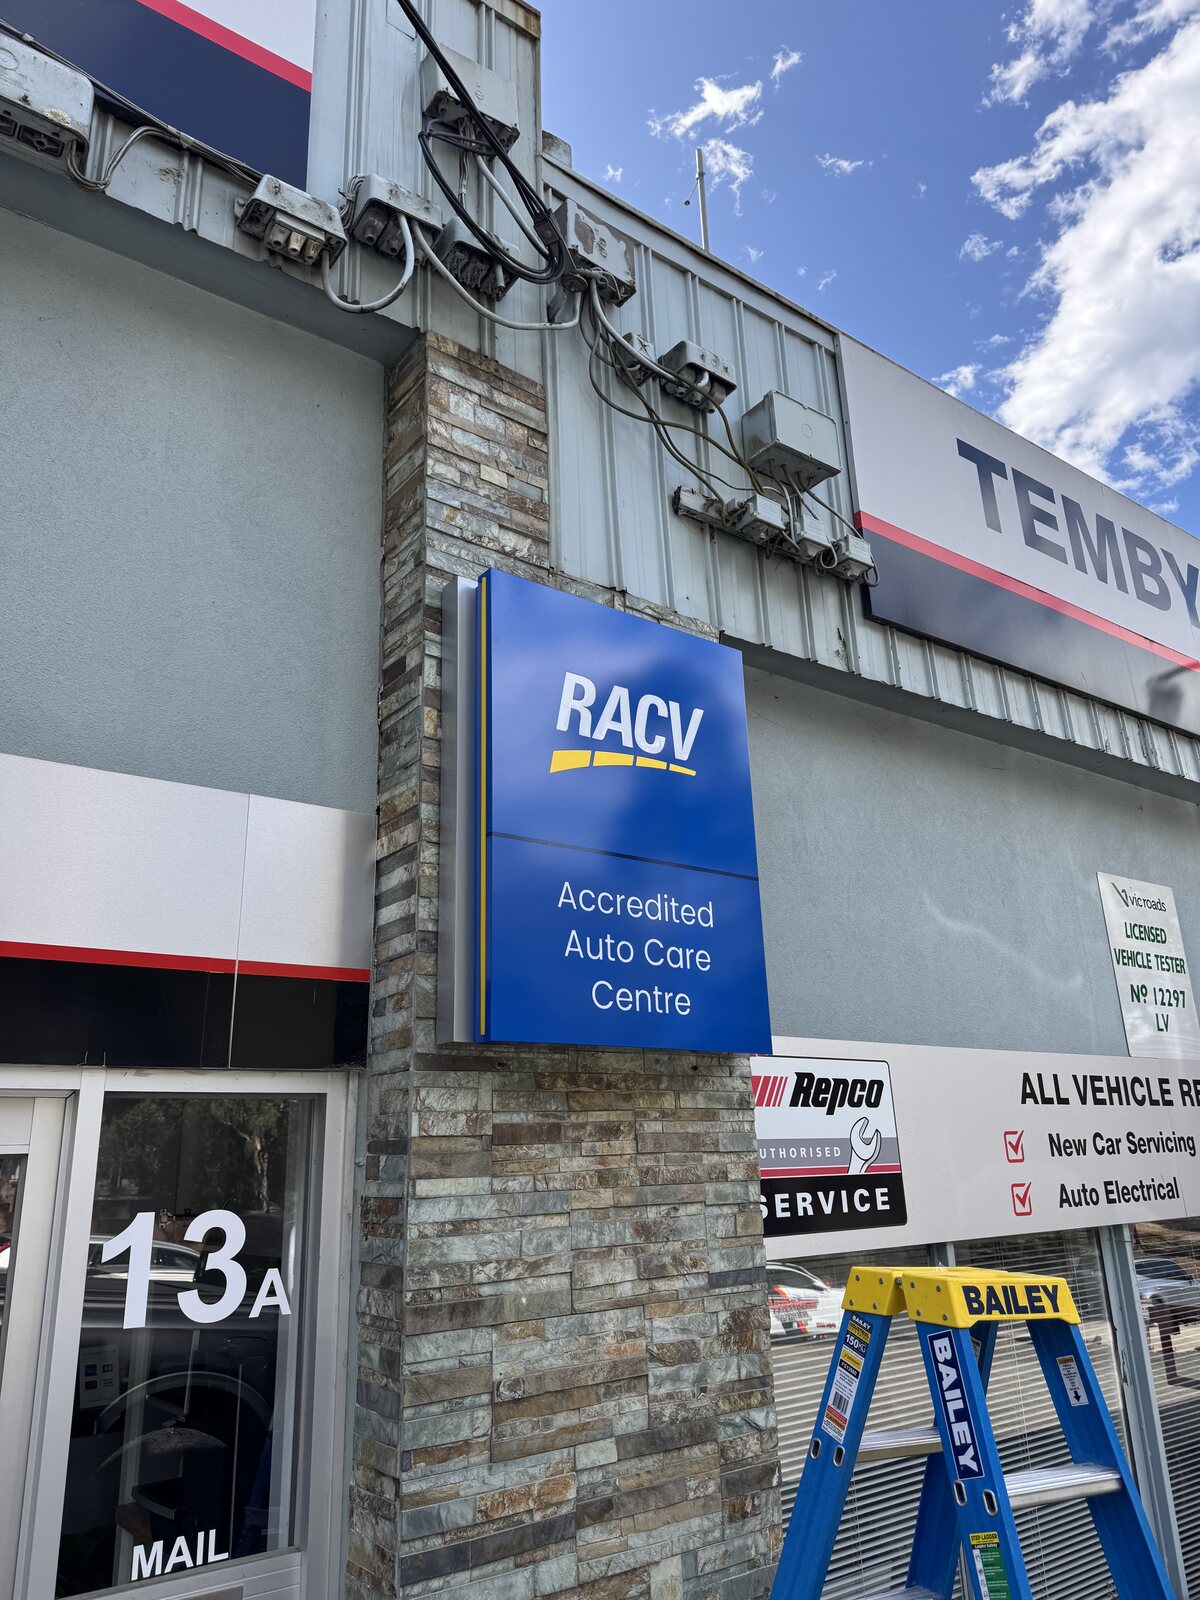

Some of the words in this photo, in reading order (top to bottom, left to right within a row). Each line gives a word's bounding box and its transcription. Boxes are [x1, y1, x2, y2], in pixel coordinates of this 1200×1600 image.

[956, 437, 1200, 629] TEMBY
[556, 671, 704, 762] RACV
[557, 881, 714, 928] Accredited
[1129, 893, 1167, 913] vicroads
[1124, 922, 1167, 944] LICENSED
[564, 929, 634, 964] Auto
[644, 938, 711, 972] Care
[1114, 947, 1152, 969] VEHICLE
[1154, 954, 1186, 975] TESTER
[591, 980, 691, 1016] Centre
[1153, 987, 1186, 1009] 12297
[1155, 1013, 1169, 1033] LV
[789, 1072, 884, 1115] Repco
[1021, 1072, 1070, 1105] ALL
[1071, 1074, 1174, 1107] VEHICLE
[759, 1146, 841, 1159] UTHORISED
[1048, 1132, 1087, 1157] New
[1092, 1131, 1122, 1156] Car
[1126, 1131, 1196, 1157] Servicing
[1059, 1183, 1100, 1208] Auto
[1103, 1176, 1180, 1204] Electrical
[961, 1284, 1060, 1315] BAILEY
[932, 1337, 979, 1473] BAILEY
[131, 1529, 229, 1581] MAIL
